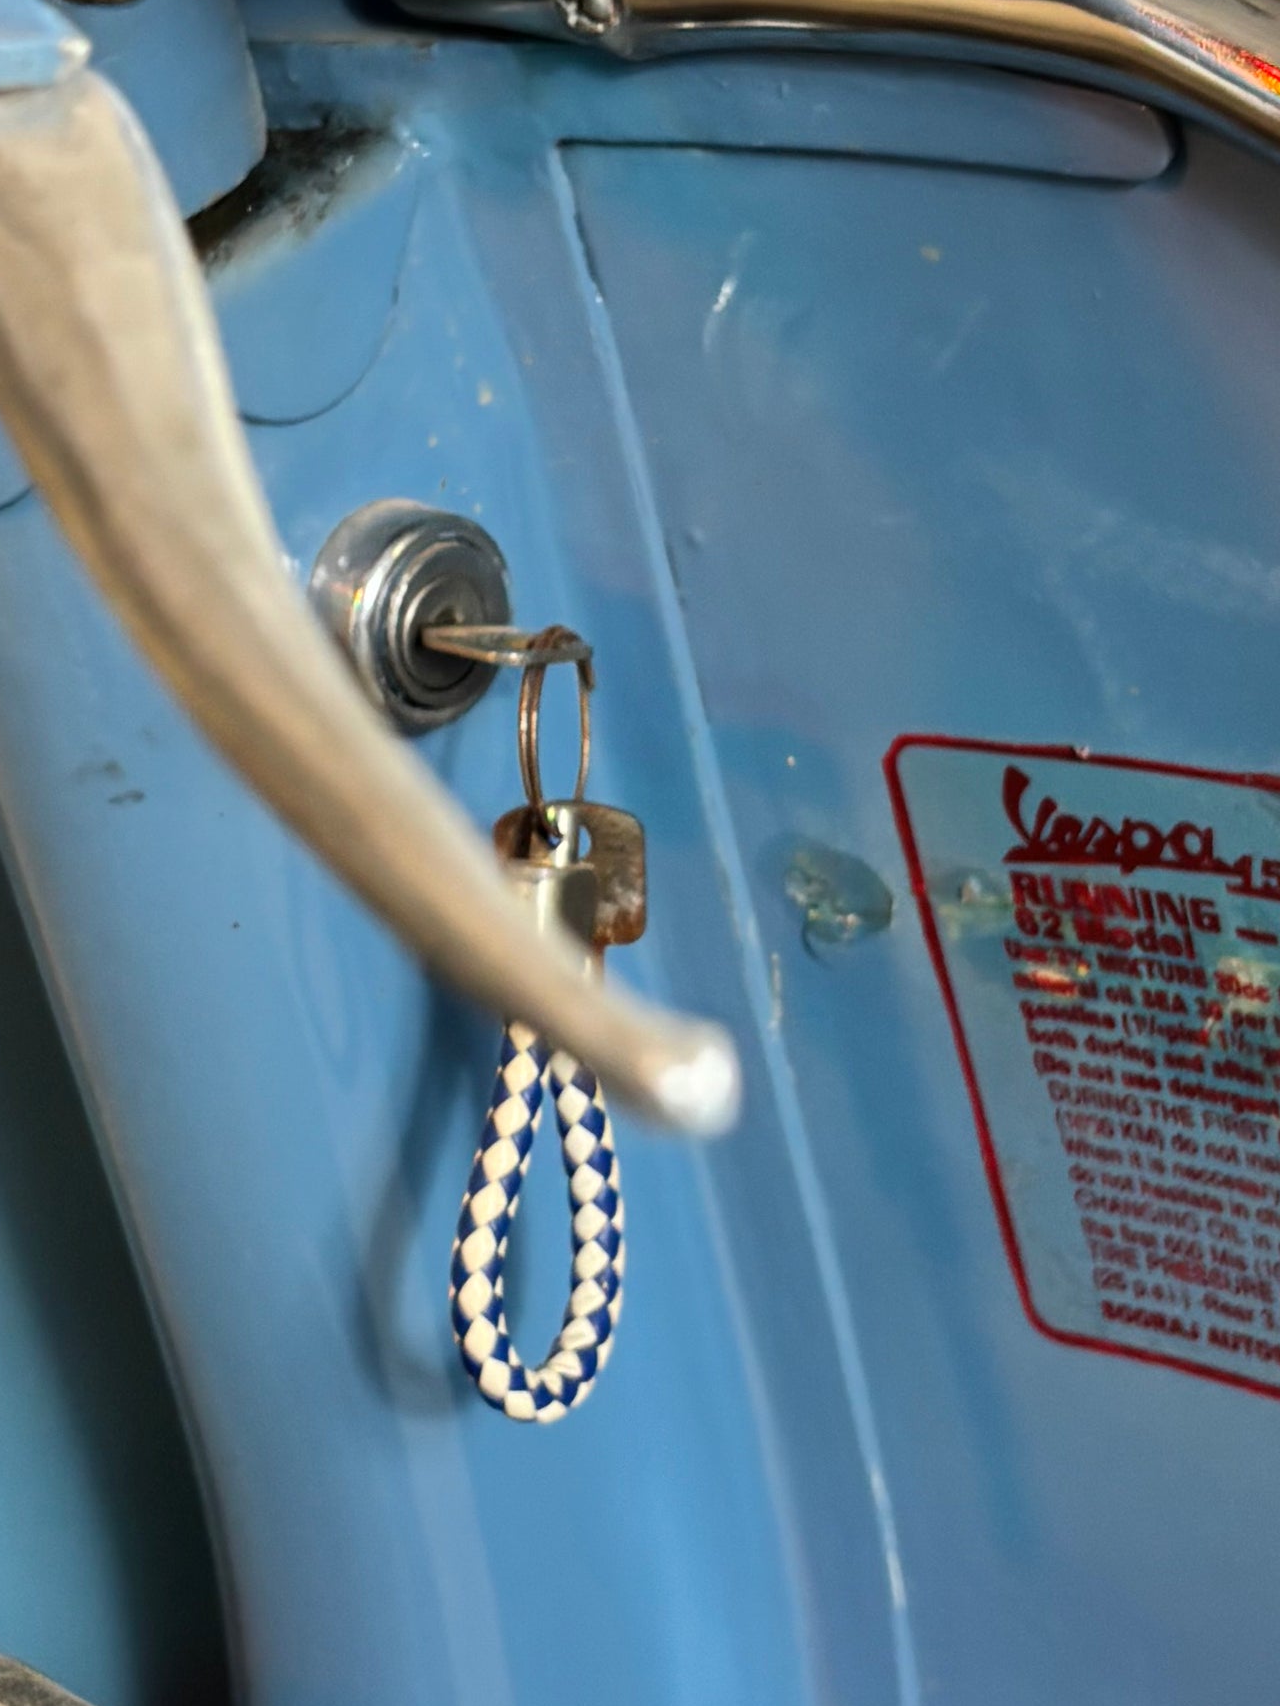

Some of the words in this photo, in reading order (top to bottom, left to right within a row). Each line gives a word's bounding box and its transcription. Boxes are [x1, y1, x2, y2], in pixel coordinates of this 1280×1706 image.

[1003, 767, 1242, 875] Vespa
[1010, 871, 1219, 933] RUNNING
[1070, 910, 1195, 959] Model
